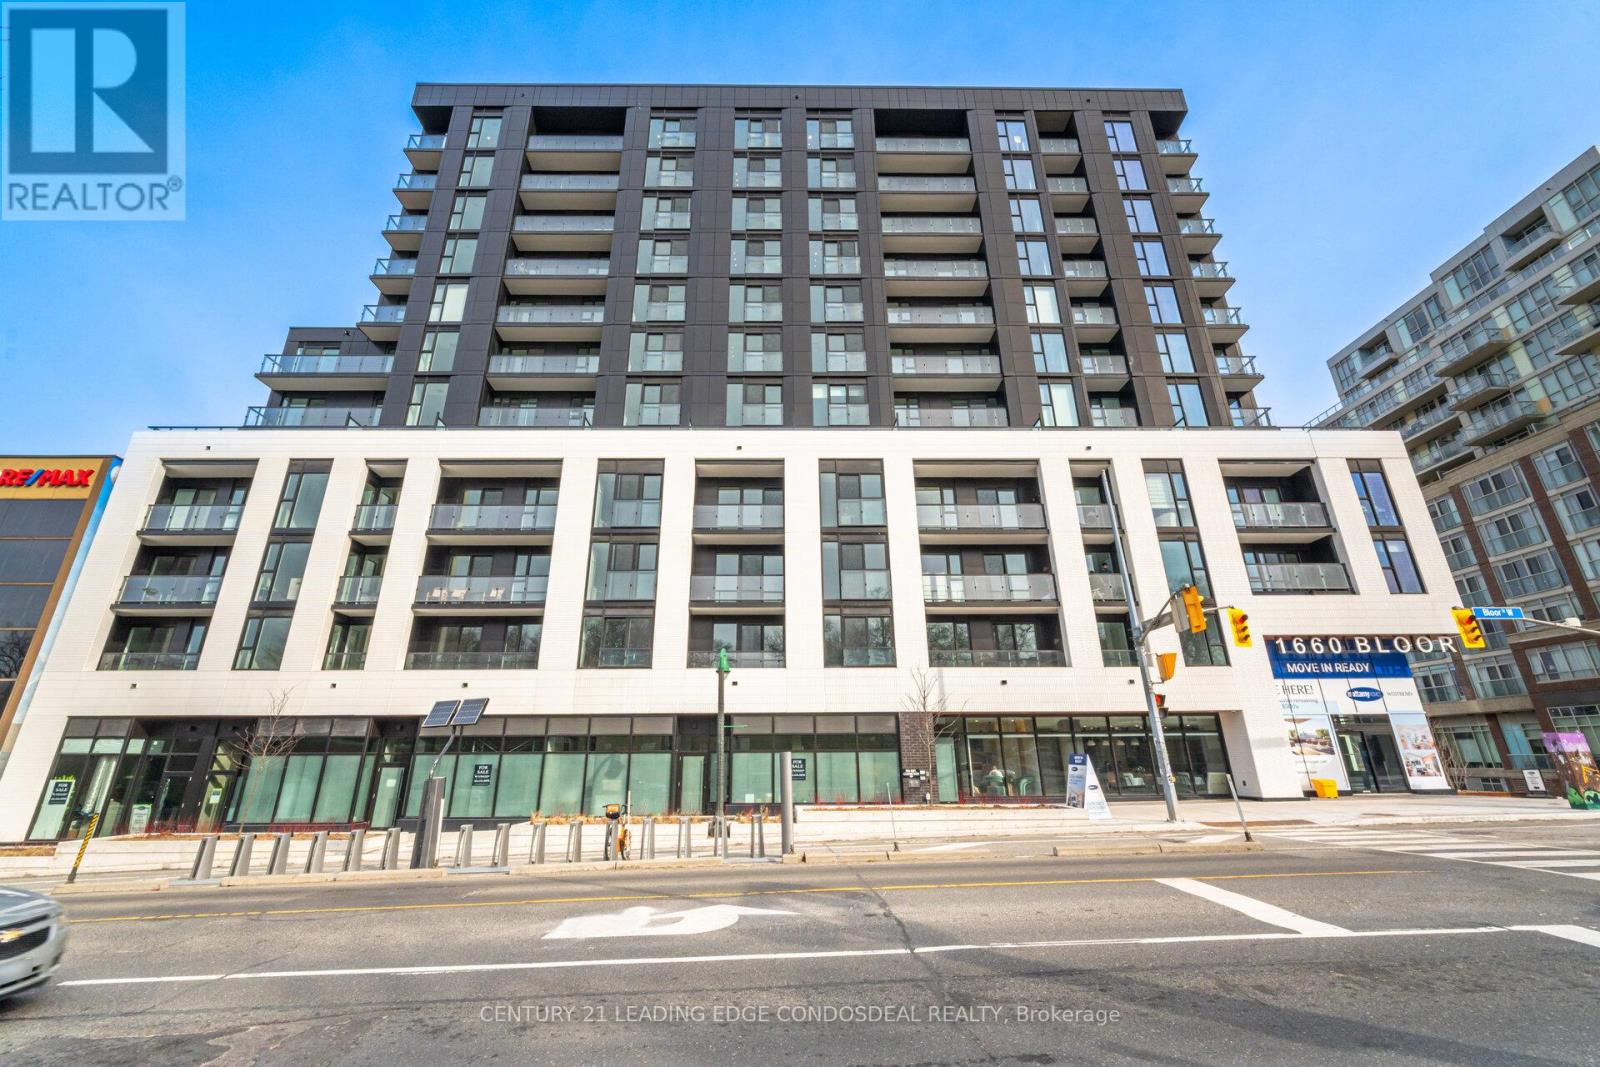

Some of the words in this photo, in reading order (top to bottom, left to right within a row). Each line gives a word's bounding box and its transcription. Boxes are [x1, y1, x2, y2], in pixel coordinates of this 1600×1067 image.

[0, 469, 95, 487] RE/MAX
[1482, 608, 1501, 616] Bloor
[1275, 636, 1342, 654] 1660
[1354, 636, 1457, 653] BLOOR
[1286, 663, 1319, 673] MOVE
[1321, 663, 1333, 673] IN
[1334, 663, 1370, 673] READY
